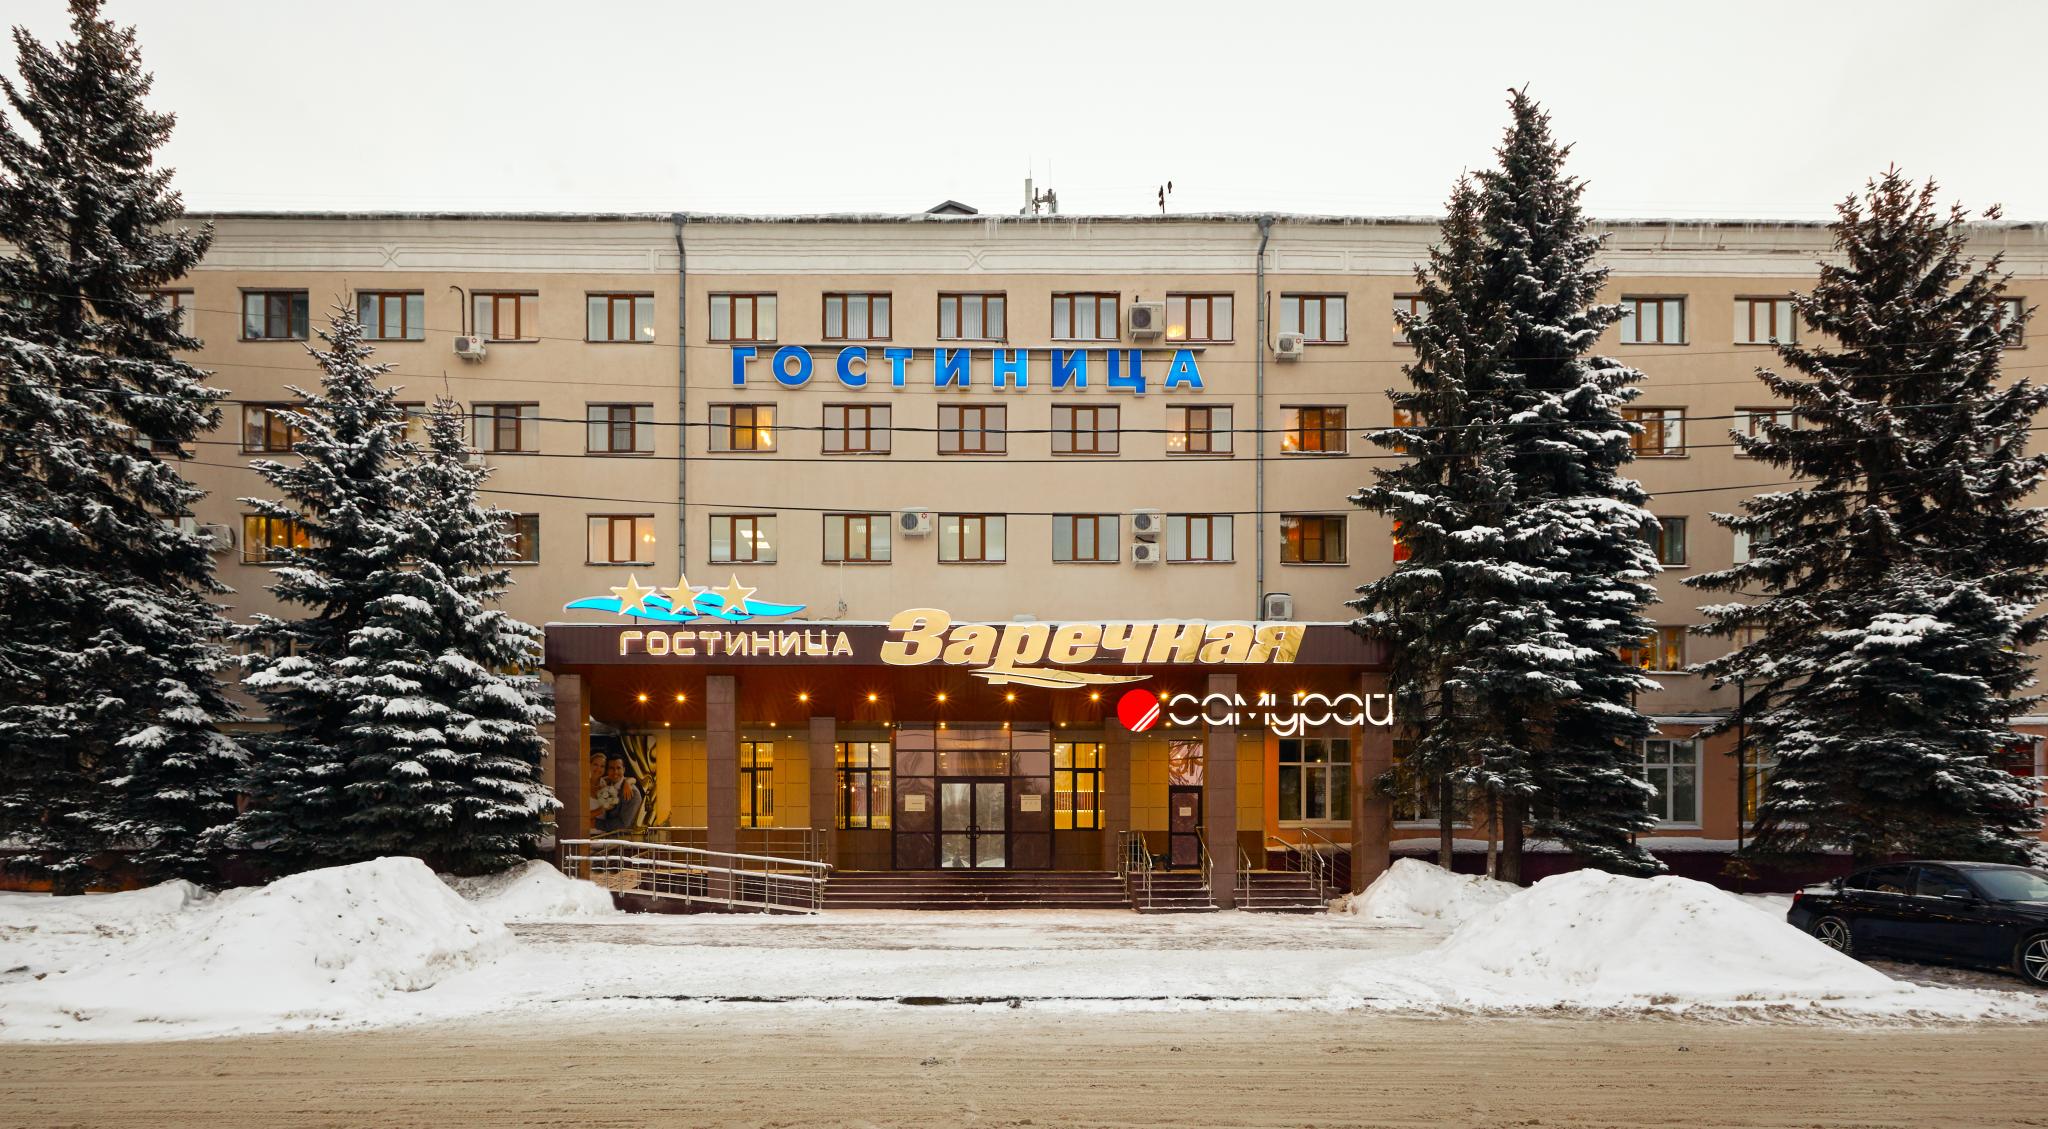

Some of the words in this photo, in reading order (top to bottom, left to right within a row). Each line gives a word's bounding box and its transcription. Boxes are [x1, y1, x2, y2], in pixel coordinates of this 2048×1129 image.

[731, 346, 1205, 396] ГОСТИНИЦА
[619, 630, 853, 656] ГОСТИНИЦА
[880, 607, 1306, 685] Заречная
[1169, 693, 1393, 736] самурай
